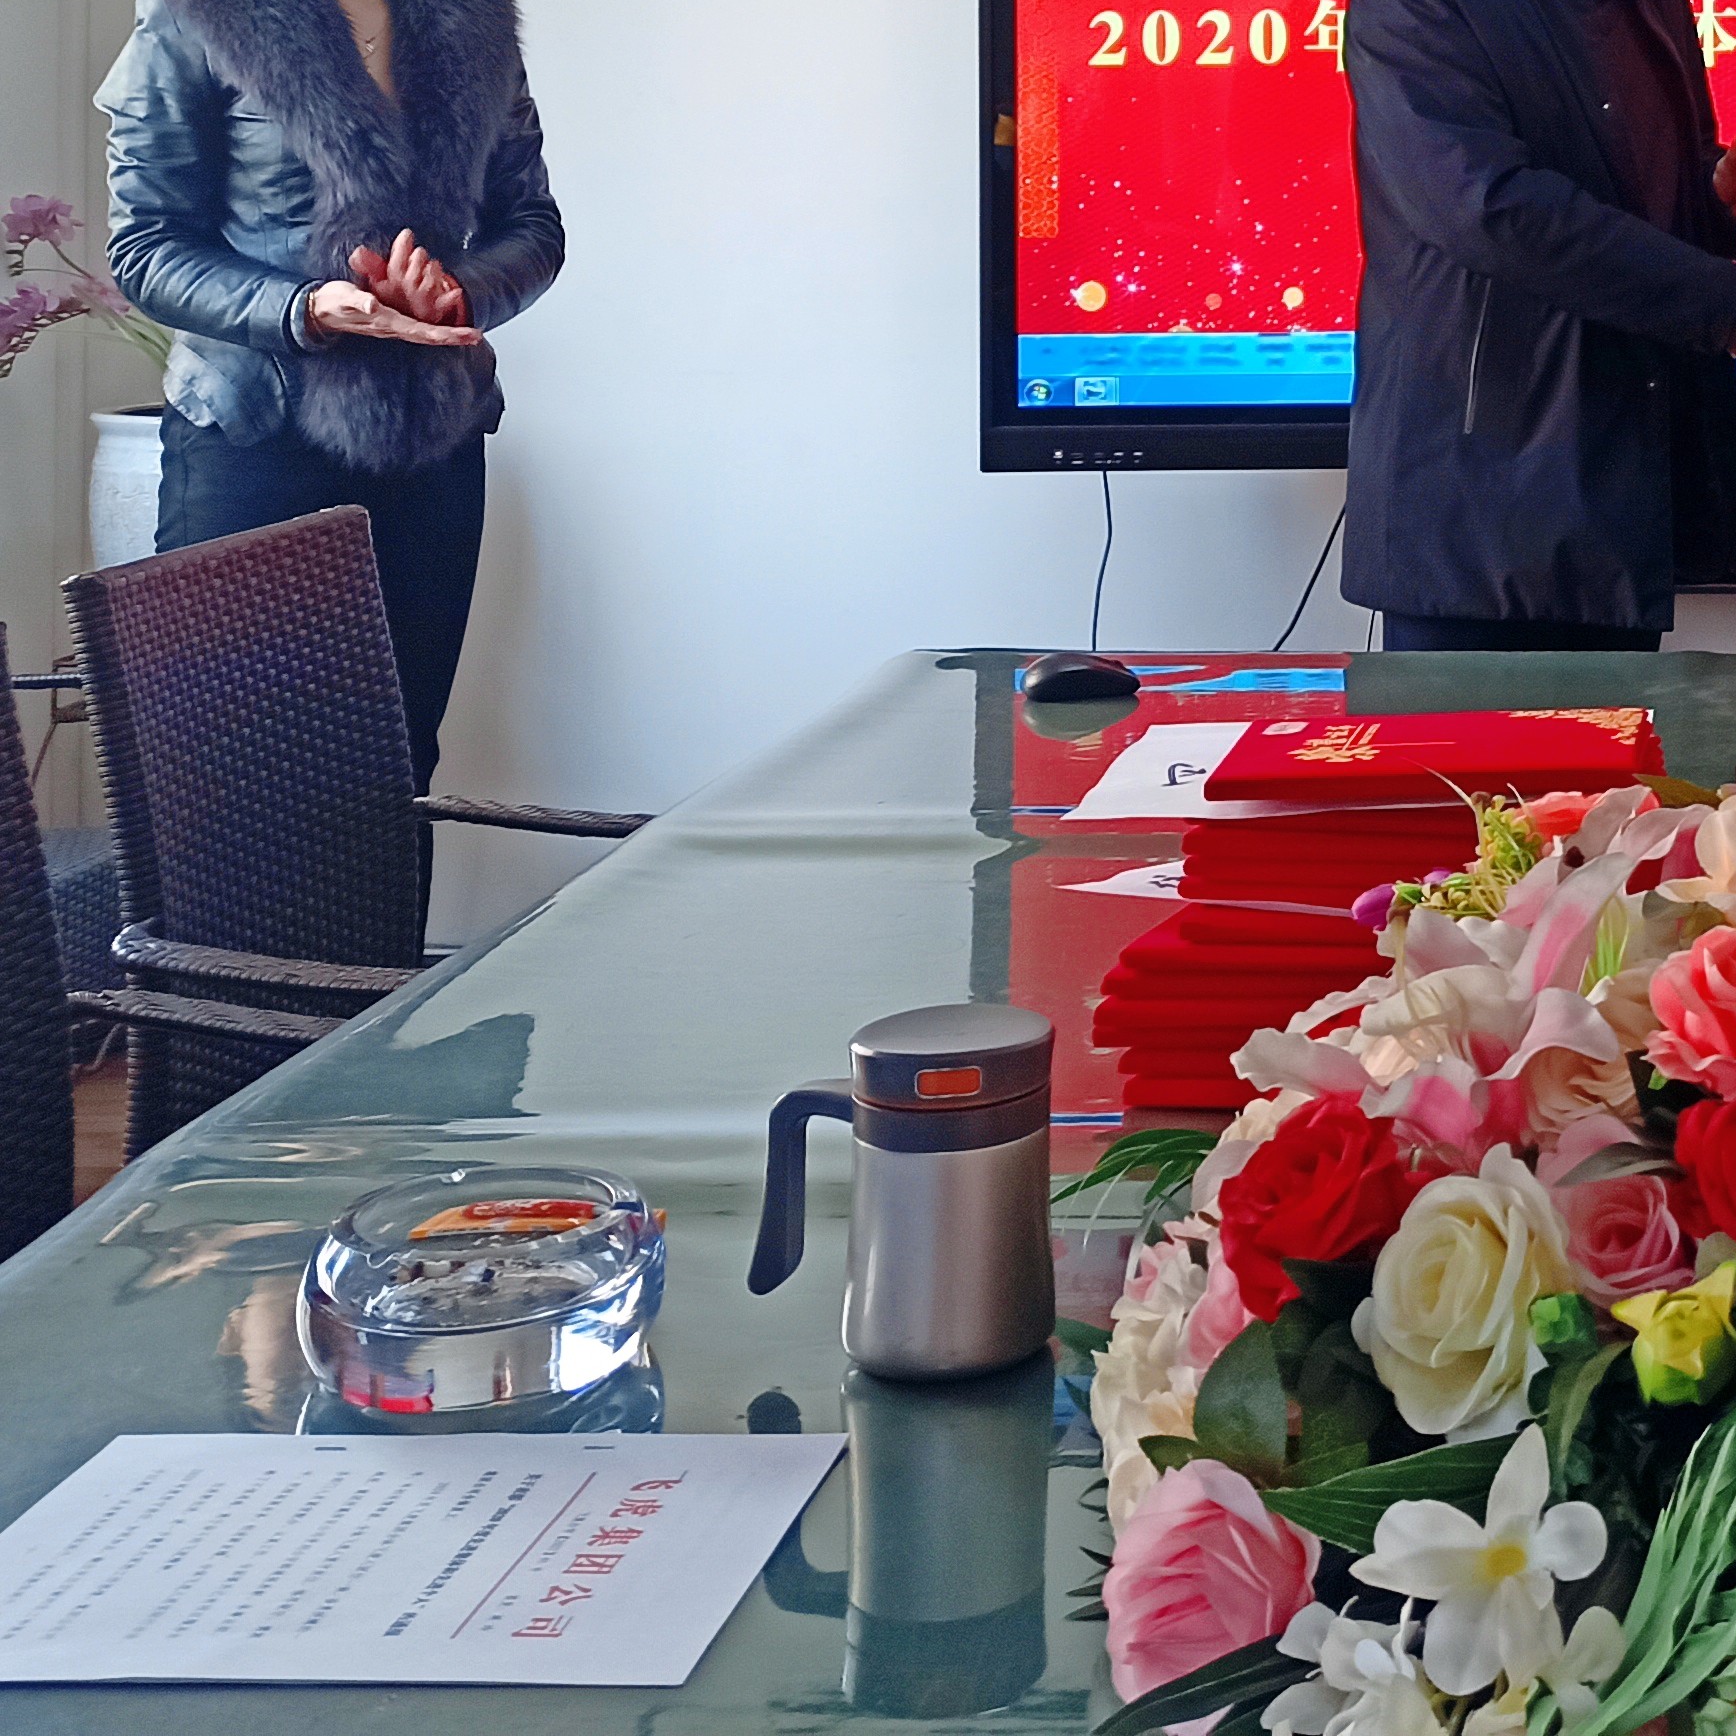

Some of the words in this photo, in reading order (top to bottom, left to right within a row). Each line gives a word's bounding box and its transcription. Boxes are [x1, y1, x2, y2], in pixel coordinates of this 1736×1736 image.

[511, 1470, 689, 1638] 飞虎集团公司
